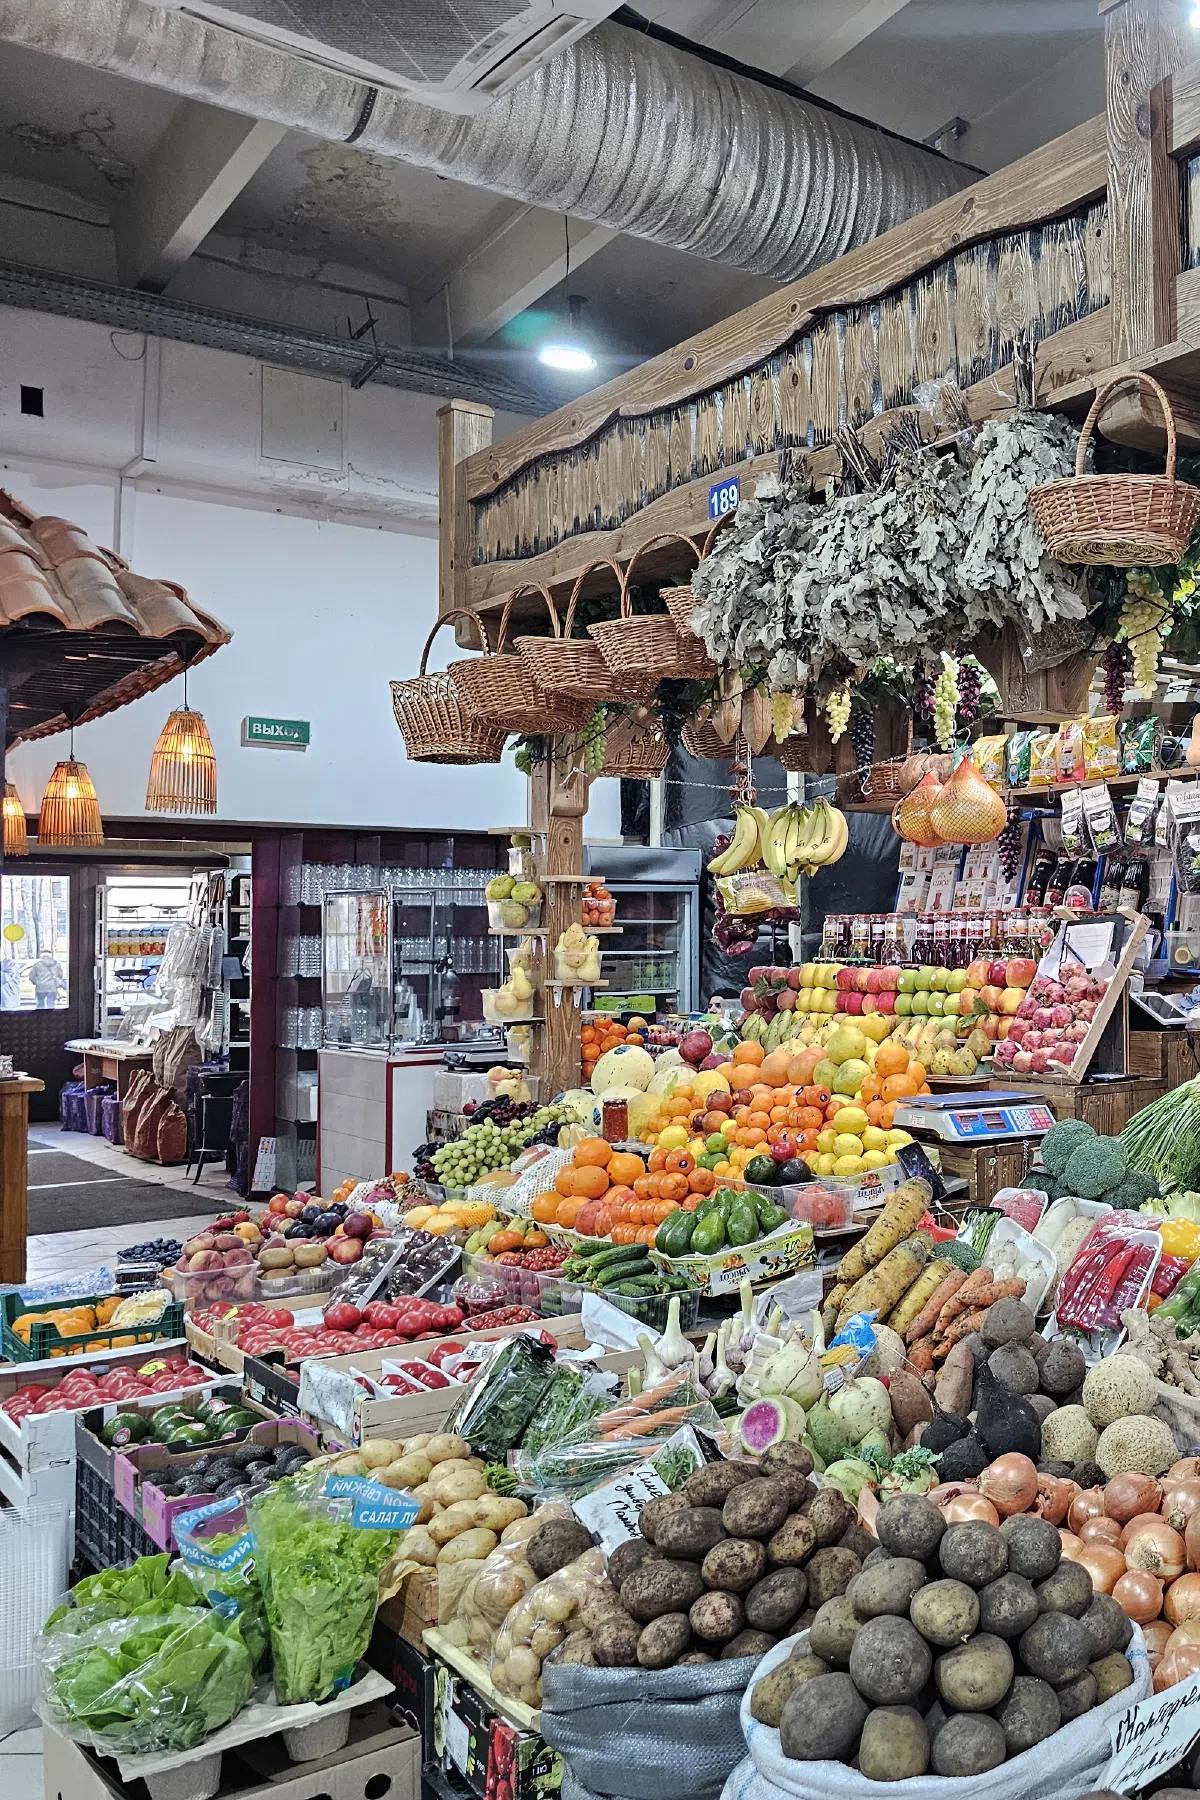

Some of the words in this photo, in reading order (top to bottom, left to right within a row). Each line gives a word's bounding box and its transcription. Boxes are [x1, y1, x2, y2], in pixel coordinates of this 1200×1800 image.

[711, 485, 738, 516] 189
[252, 722, 303, 738] ВЫХ
[637, 1471, 663, 1498] Сине
[360, 1510, 396, 1524] САЛАТ
[400, 1510, 417, 1524] ЛИ
